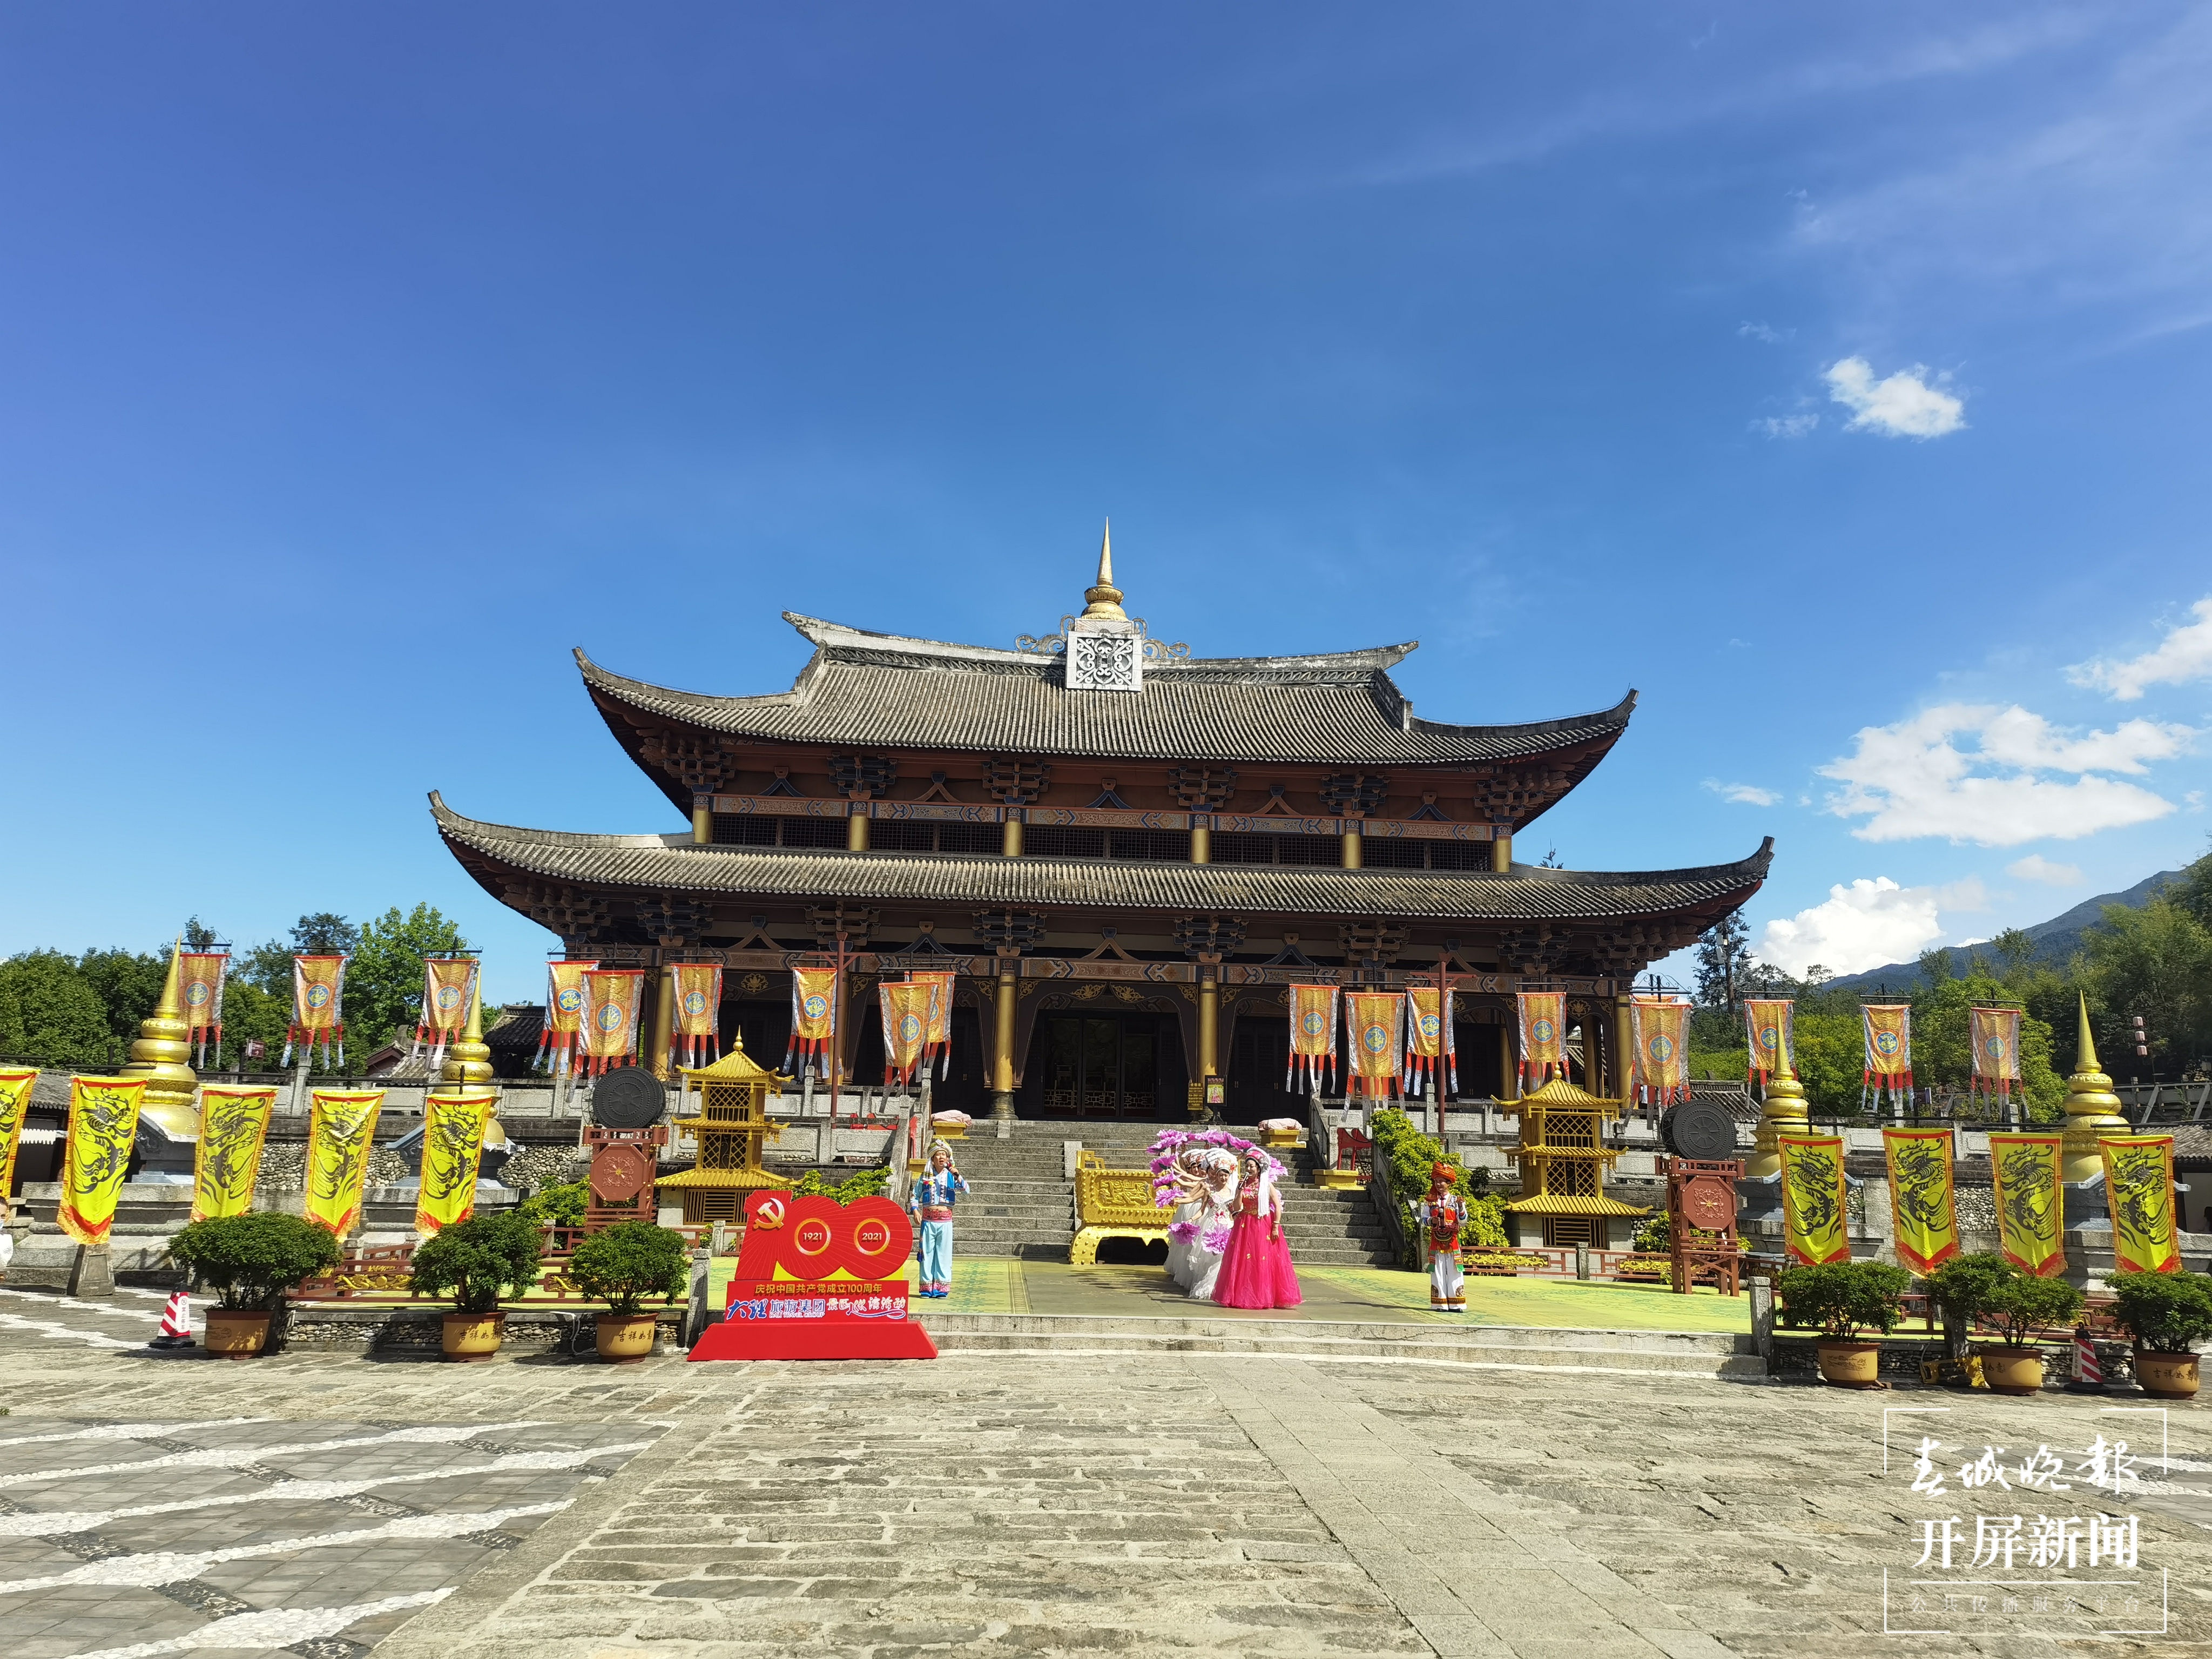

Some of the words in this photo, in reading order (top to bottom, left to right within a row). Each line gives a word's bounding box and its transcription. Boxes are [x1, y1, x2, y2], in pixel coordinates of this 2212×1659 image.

[802, 1232, 822, 1241] 1921
[862, 1232, 882, 1241] 2021
[755, 1283, 882, 1294] 庆祝中国共产党成立100周年
[726, 1298, 825, 1320] 大理旅游集团
[618, 1329, 653, 1342] 吉祥如意
